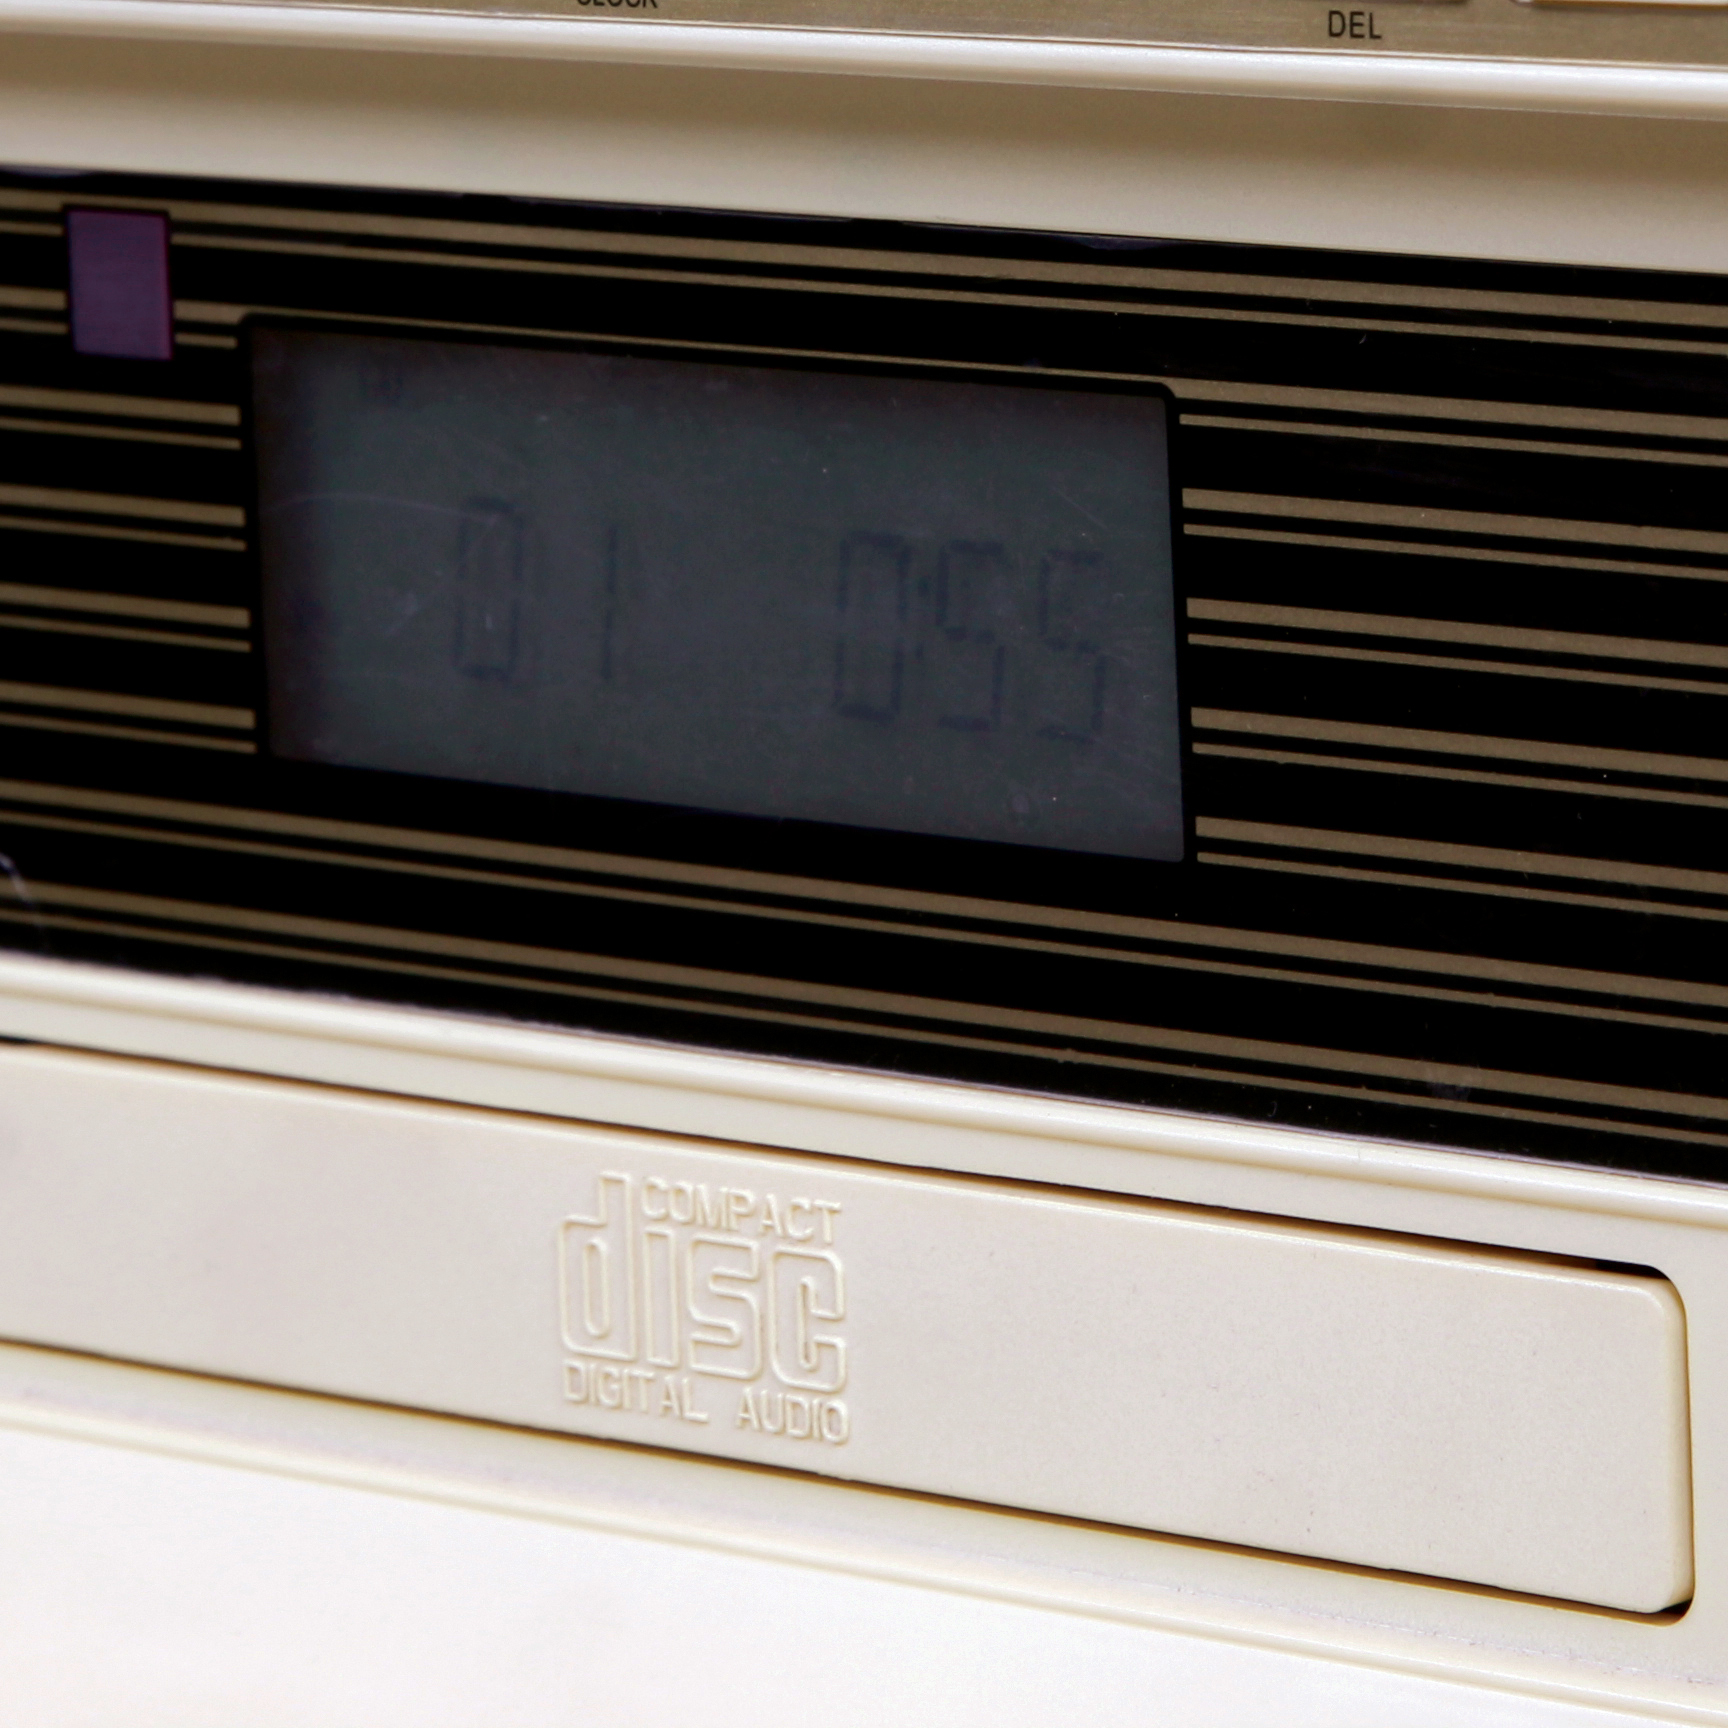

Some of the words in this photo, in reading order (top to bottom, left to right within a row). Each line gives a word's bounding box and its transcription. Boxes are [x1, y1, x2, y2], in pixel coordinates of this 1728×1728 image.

[1327, 9, 1383, 41] DEL
[641, 1174, 843, 1246] COMPACT
[562, 1357, 710, 1425] DIGITAL
[735, 1384, 852, 1448] AUDIO
